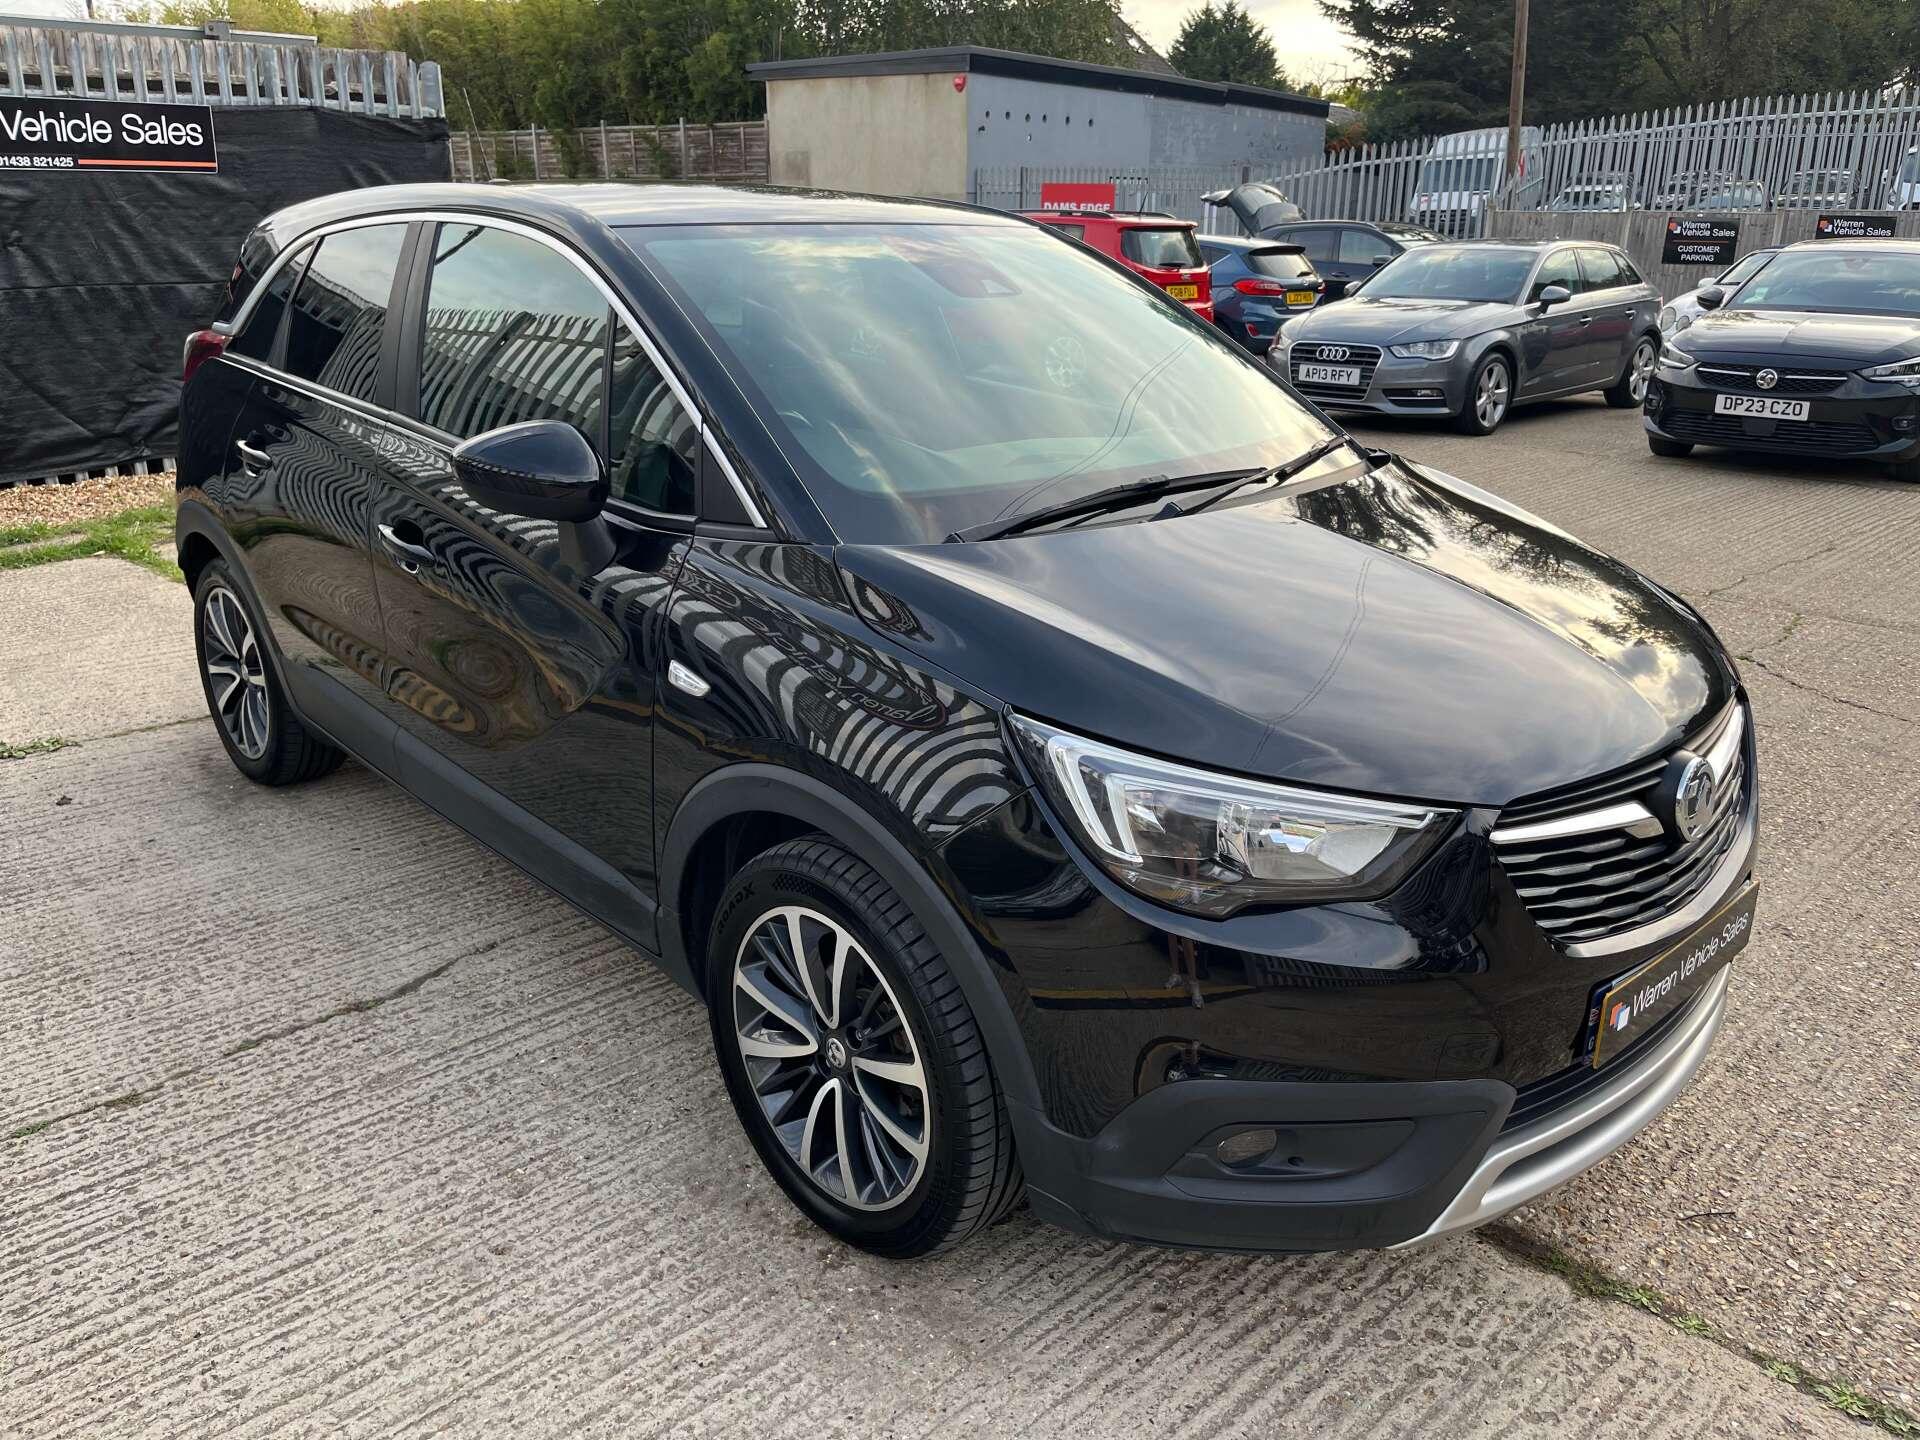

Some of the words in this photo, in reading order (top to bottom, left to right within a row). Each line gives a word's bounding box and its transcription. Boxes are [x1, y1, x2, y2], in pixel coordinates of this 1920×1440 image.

[0, 109, 113, 144] Vehicle
[121, 113, 204, 146] Sales
[33, 156, 74, 168] 821425
[1682, 221, 1711, 229] Warren
[1833, 219, 1865, 228] Warren
[1682, 228, 1711, 237] Vehicle
[1712, 228, 1736, 237] Sales
[1833, 226, 1865, 236] Vehicle
[1866, 227, 1892, 236] Sales
[1677, 245, 1720, 253] CUSTOMER
[1680, 254, 1714, 262] PARKING
[1304, 367, 1328, 380] AP13
[1330, 369, 1353, 382] RFY
[1723, 396, 1766, 413] DP23
[1770, 400, 1803, 416] CZO
[1632, 970, 1679, 1017] Warren
[1680, 936, 1719, 982] Vehicle
[1720, 912, 1749, 948] Sales
